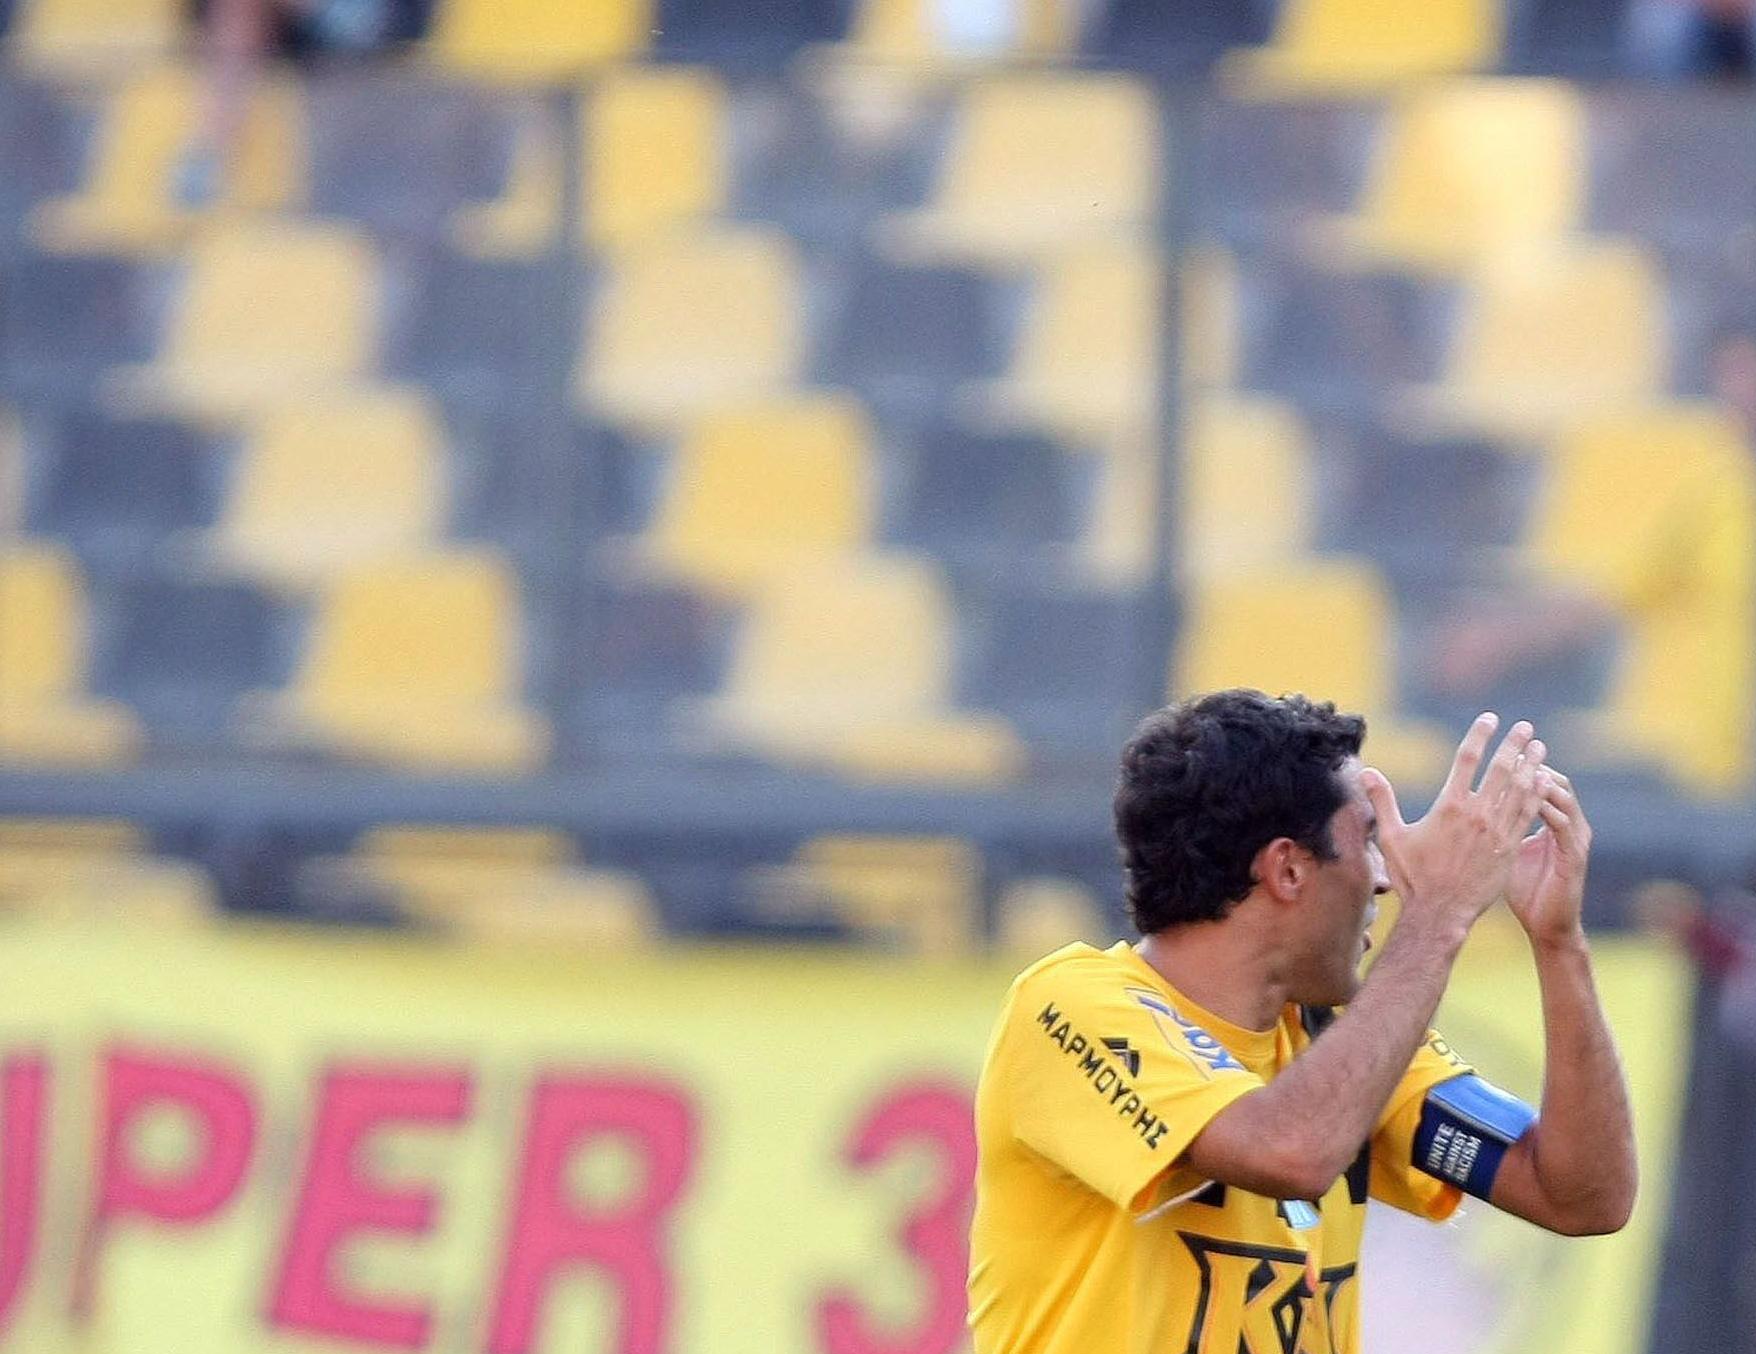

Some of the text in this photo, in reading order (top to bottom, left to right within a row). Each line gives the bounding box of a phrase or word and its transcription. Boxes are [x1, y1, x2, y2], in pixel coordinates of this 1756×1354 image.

[1037, 1001, 1168, 1150] ΜΑΡΜΟΥΡΗΣ
[1427, 1122, 1455, 1170] UNITE
[1455, 1134, 1483, 1183] RACISM
